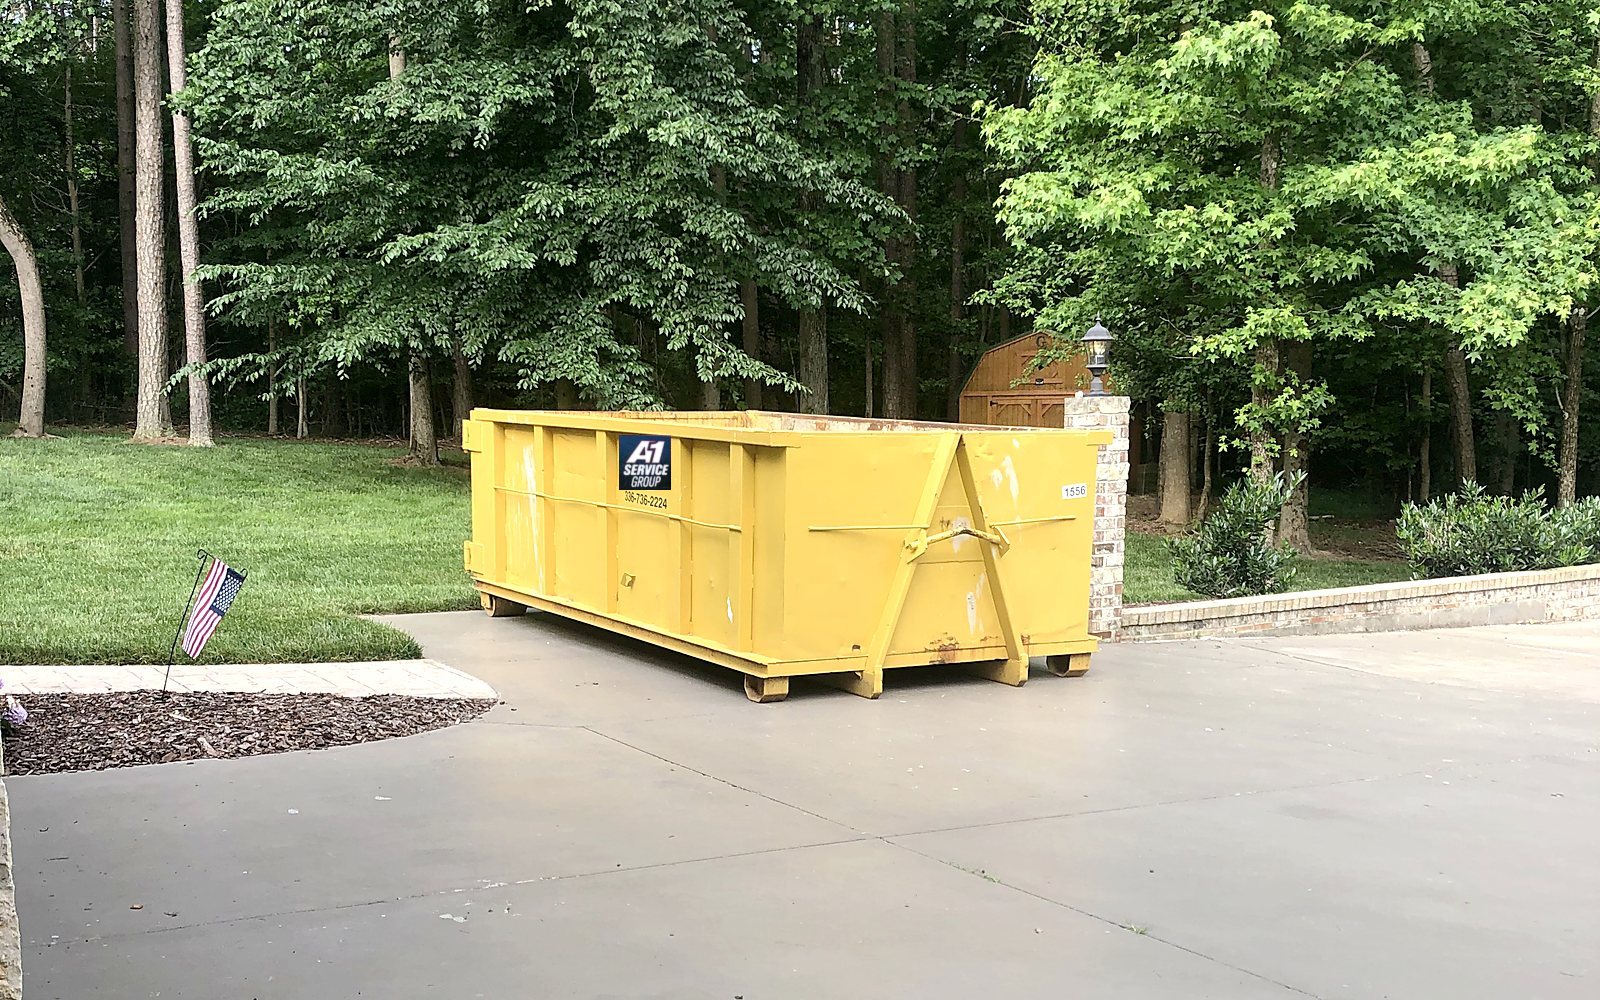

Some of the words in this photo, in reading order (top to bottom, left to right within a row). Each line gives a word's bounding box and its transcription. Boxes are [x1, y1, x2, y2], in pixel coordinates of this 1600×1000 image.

[625, 440, 665, 464] A1
[623, 464, 669, 476] SERVICE
[631, 476, 661, 488] GROUP
[1065, 485, 1086, 496] 1556
[625, 490, 667, 509] 336-736-2224
